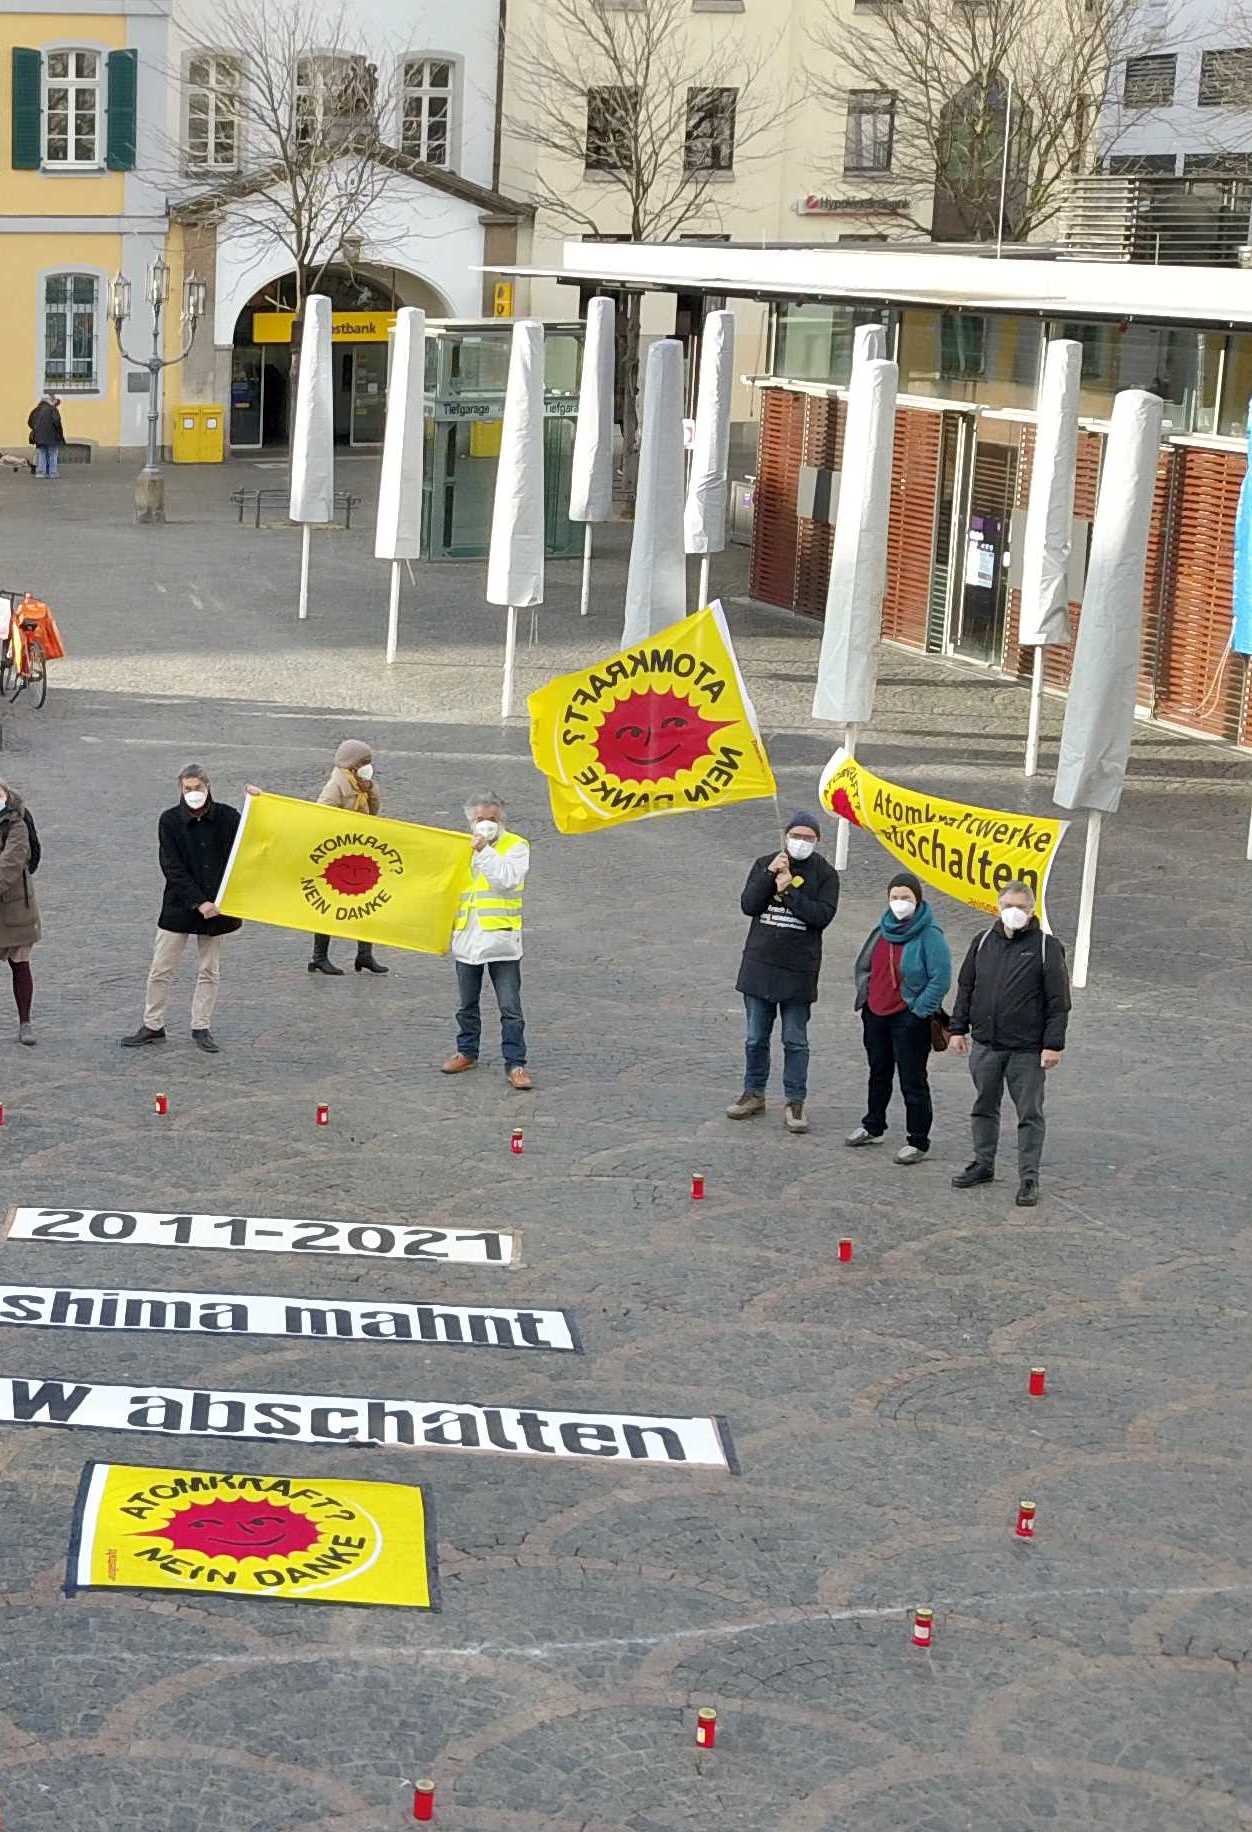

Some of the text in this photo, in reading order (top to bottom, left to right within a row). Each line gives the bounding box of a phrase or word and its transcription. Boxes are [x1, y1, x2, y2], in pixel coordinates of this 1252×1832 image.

[332, 321, 377, 335] stbank
[444, 402, 490, 417] Tiefgarage
[309, 832, 404, 876] ATOMKRAFT?
[301, 877, 392, 921] NEIN DANKE
[31, 1209, 503, 1261] 2011-2021
[284, 1305, 552, 1347] mahnt
[126, 1392, 688, 1461] abschalten
[119, 1474, 356, 1521] ATOMKRAFT?
[133, 1547, 237, 1585] NEIN
[253, 1534, 367, 1588] DANKE
